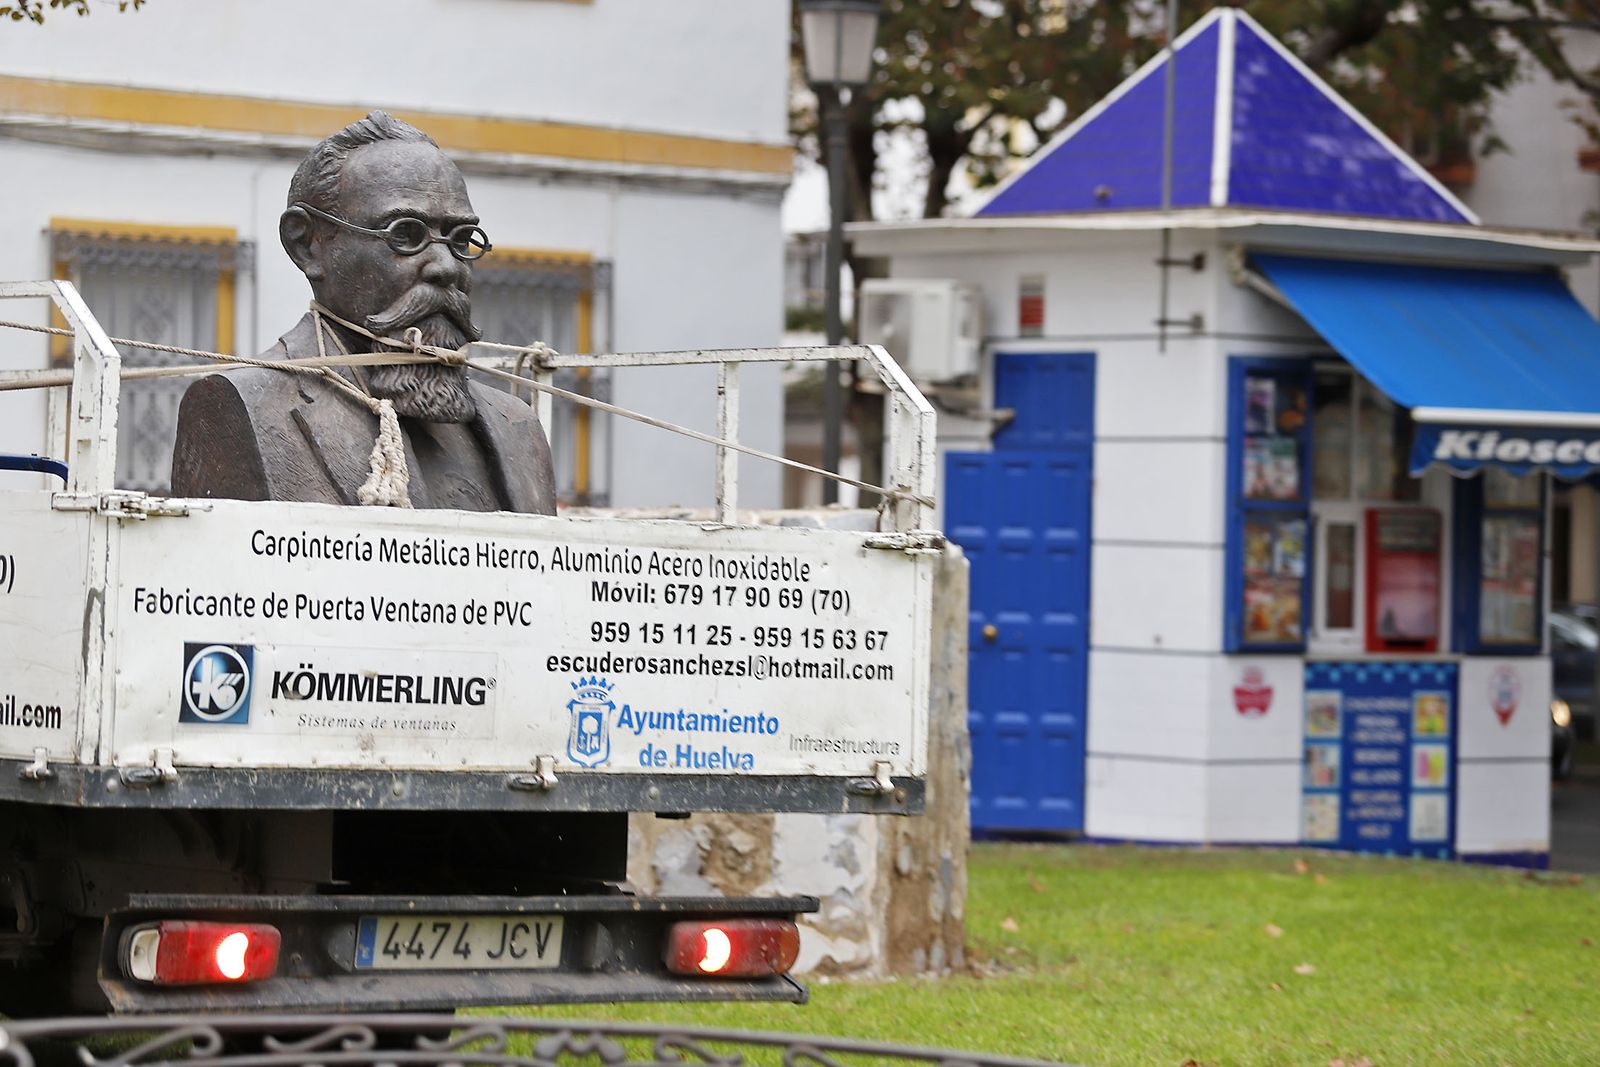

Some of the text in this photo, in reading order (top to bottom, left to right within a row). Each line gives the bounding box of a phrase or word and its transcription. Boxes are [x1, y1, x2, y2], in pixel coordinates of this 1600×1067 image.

[251, 529, 811, 583] Carpintería Metálica Hierro, Aluminio Acero Inoxidable
[134, 586, 533, 628] Fabricante de Puerta Ventana de PVC
[591, 580, 851, 617] Móvil: 679 17 90 69 (70)
[590, 620, 631, 644] 959
[638, 622, 665, 645] 15
[673, 623, 696, 646] 11
[705, 624, 732, 647] 25
[753, 626, 792, 648] 959
[800, 627, 825, 650] 15
[832, 628, 857, 651] 63
[864, 629, 889, 652] 67
[546, 650, 894, 681] escuderosanchezsl@hotmail.com
[297, 713, 457, 732] Sistemas de ventanas
[616, 704, 780, 736] Ayuntamiento
[639, 743, 754, 771] de Huelva
[789, 733, 900, 755] Infraestructura
[382, 921, 472, 961] 4474
[486, 921, 554, 960] JCV
